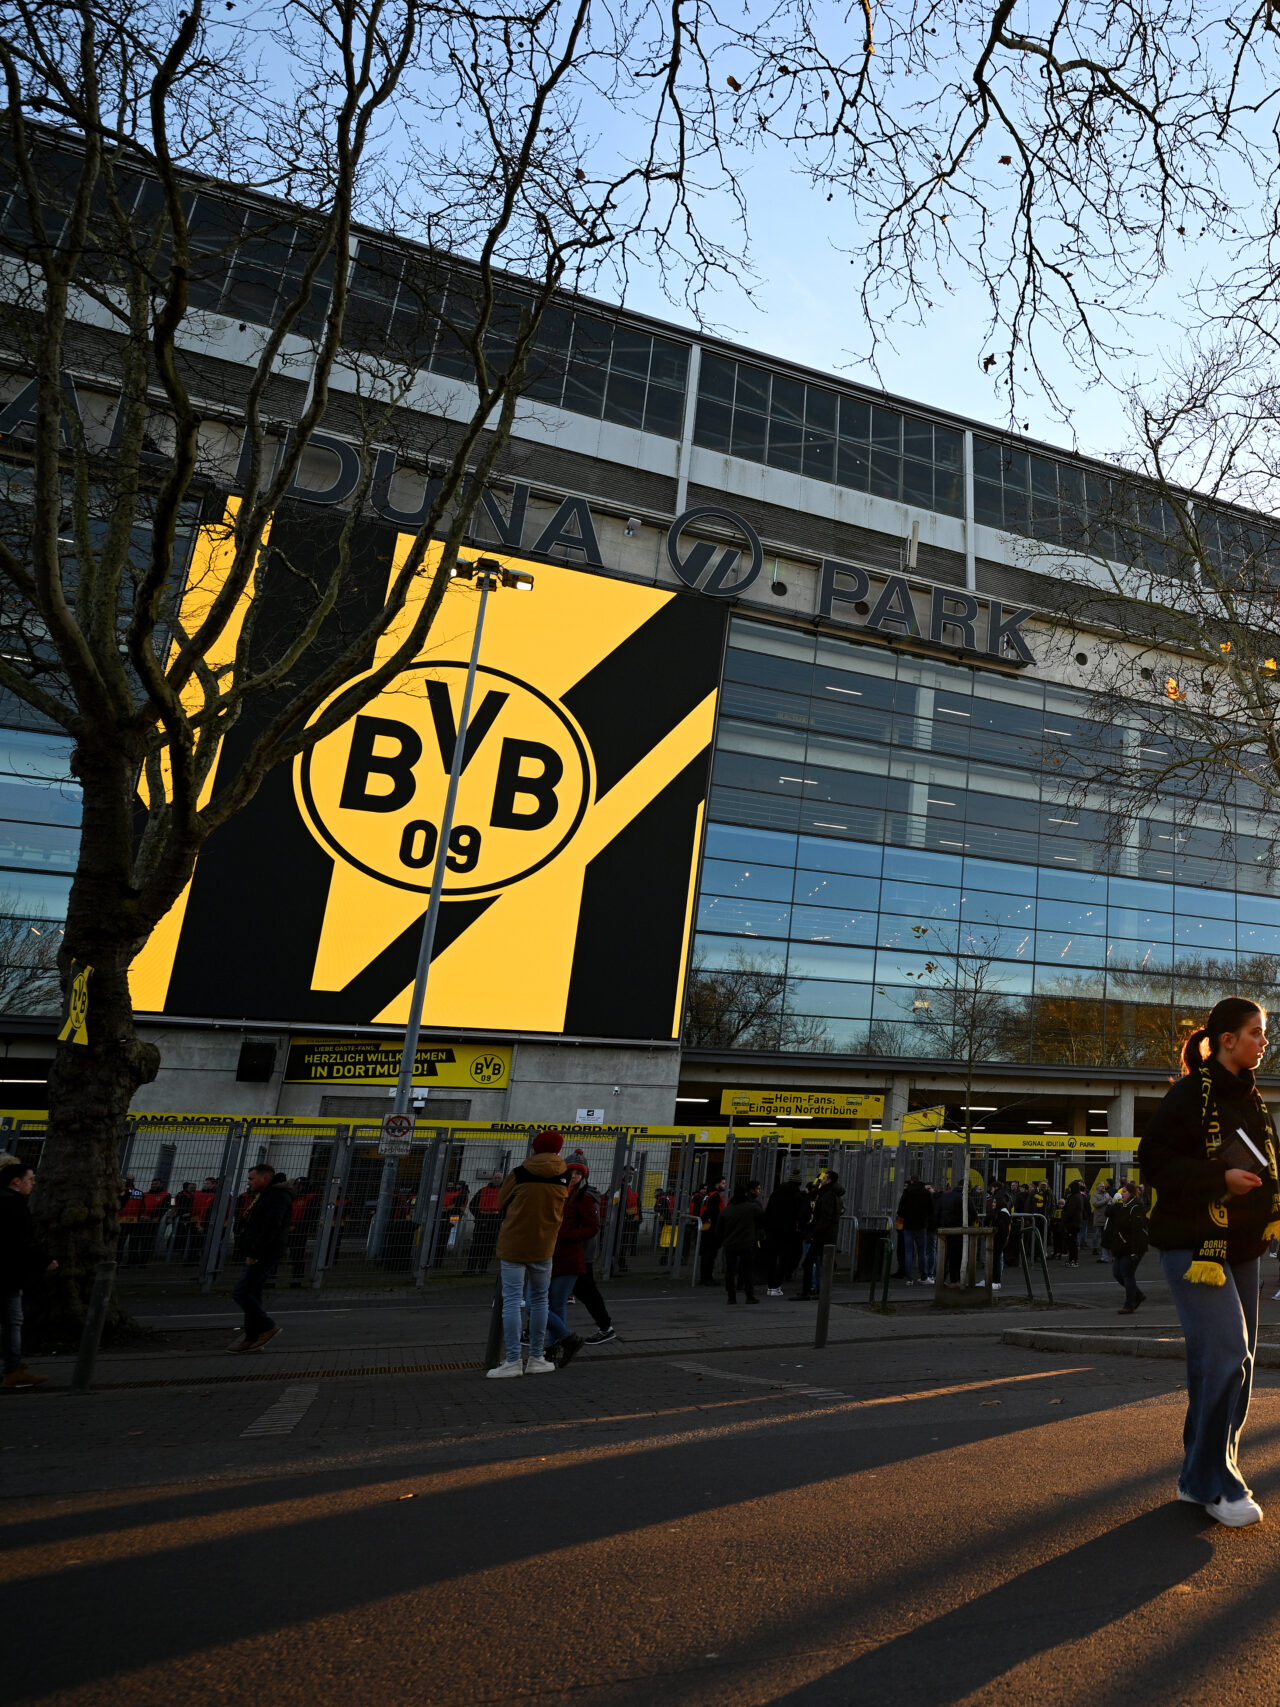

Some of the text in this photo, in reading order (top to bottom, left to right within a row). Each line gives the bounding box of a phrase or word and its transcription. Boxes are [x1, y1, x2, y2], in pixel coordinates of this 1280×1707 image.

[236, 424, 605, 568] IDUNA
[819, 557, 1038, 666] PARK
[339, 679, 564, 831] BVB
[399, 819, 482, 873] 09
[304, 1051, 447, 1064] HERZLICH WILLKMMEN
[310, 1063, 428, 1078] IN DORTMUD!
[474, 1057, 503, 1076] BVB
[480, 1074, 492, 1082] 09
[774, 1094, 836, 1105] Heim-Fans:
[749, 1103, 792, 1115] Eingang
[794, 1104, 858, 1116] Nordtribüne
[182, 1115, 294, 1125] NORD-MITTE
[490, 1123, 649, 1134] EINGANG NORD-MITTE
